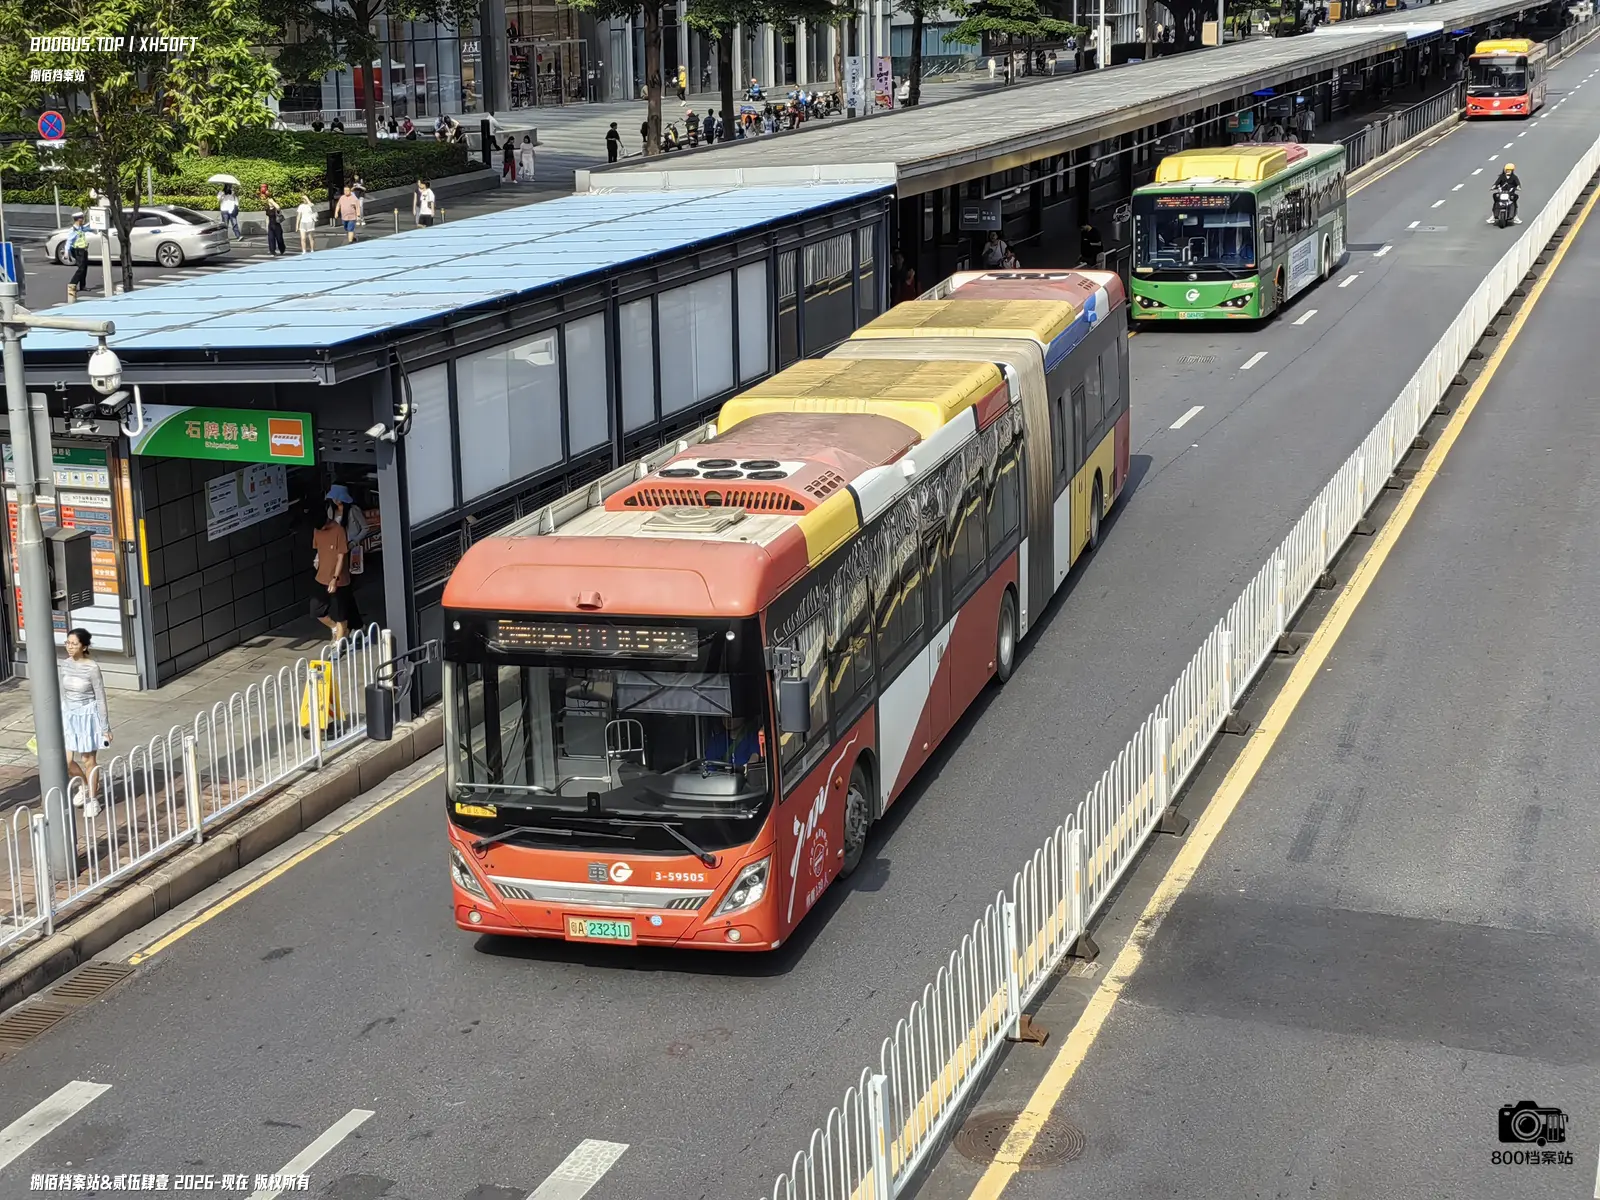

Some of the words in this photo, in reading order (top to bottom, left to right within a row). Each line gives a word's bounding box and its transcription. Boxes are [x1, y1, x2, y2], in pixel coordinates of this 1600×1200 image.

[185, 420, 259, 443] 石牌桥站
[654, 871, 705, 883] 3-59505
